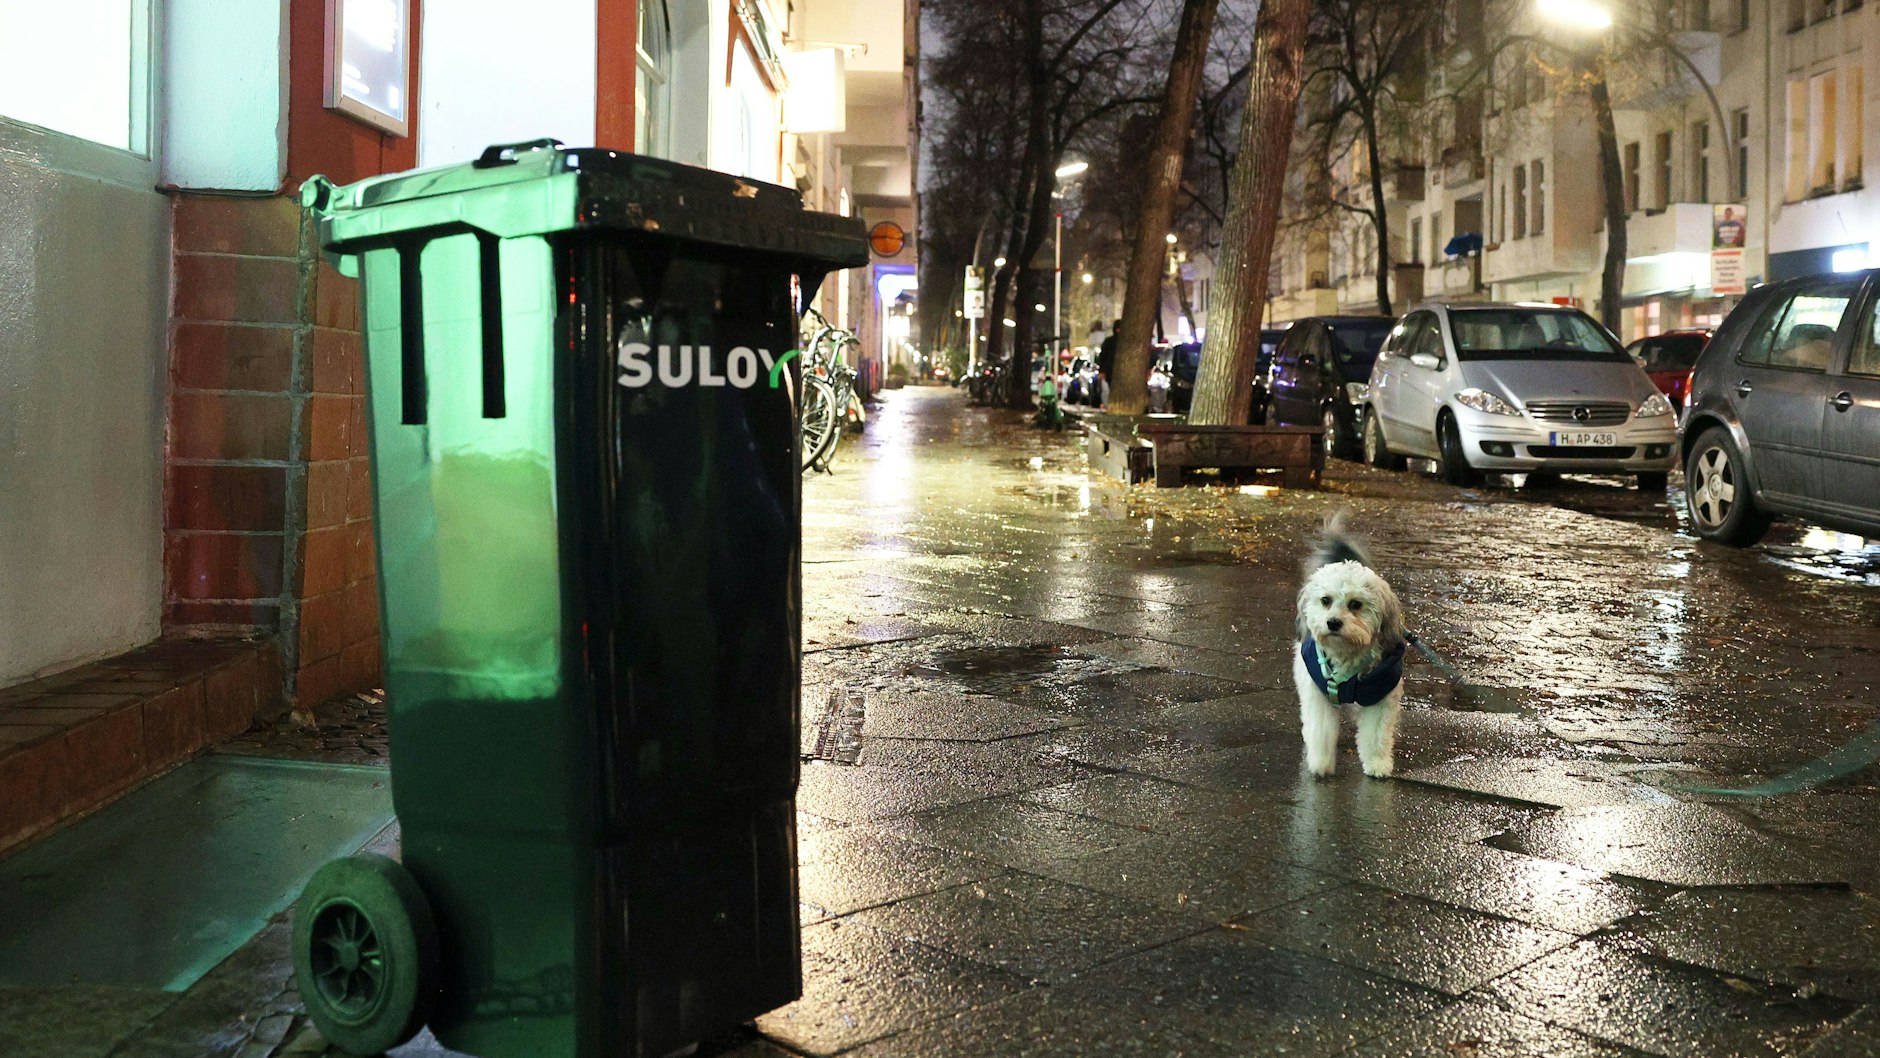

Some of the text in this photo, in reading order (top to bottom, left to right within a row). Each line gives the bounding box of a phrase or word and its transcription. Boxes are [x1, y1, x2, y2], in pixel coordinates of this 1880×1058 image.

[1561, 433, 1613, 445] H AP 438
